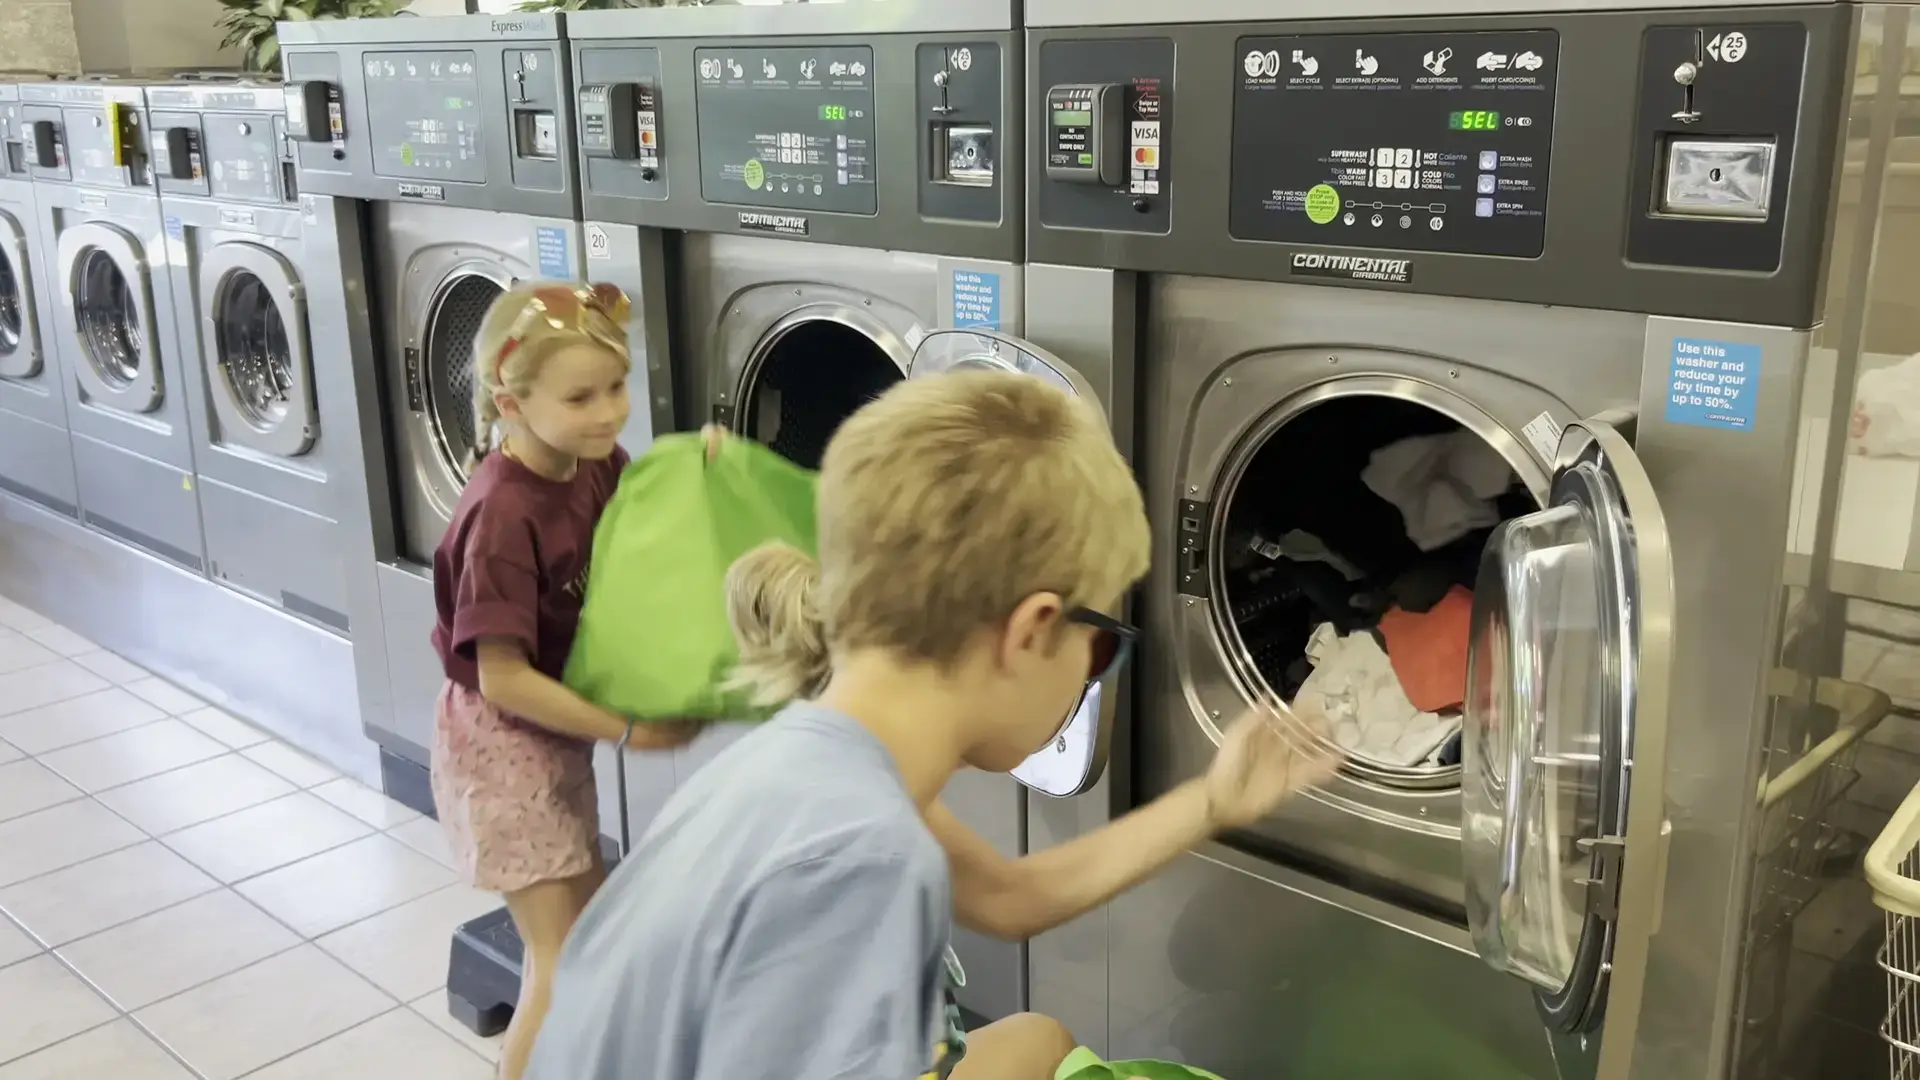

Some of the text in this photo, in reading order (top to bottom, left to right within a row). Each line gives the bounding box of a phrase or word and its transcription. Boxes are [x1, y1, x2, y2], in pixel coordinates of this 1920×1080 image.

[1726, 37, 1743, 48] 25
[961, 52, 969, 60] 25
[825, 106, 845, 120] SEL
[1462, 111, 1495, 128] SEL
[640, 117, 654, 125] VISA
[1134, 128, 1158, 139] VISA
[1401, 154, 1407, 164] 2
[1382, 175, 1388, 184] 3
[1400, 175, 1406, 185] 4
[741, 213, 806, 228] CONTINENTAL
[592, 234, 604, 248] 20
[1293, 254, 1410, 274] CONTINENTAL
[955, 273, 968, 281] Use
[1677, 342, 1725, 356] Use this
[1676, 357, 1744, 372] washer and
[1675, 369, 1746, 385] reduce your
[1673, 381, 1739, 399] dry time by
[1672, 394, 1733, 409] up to 50%.
